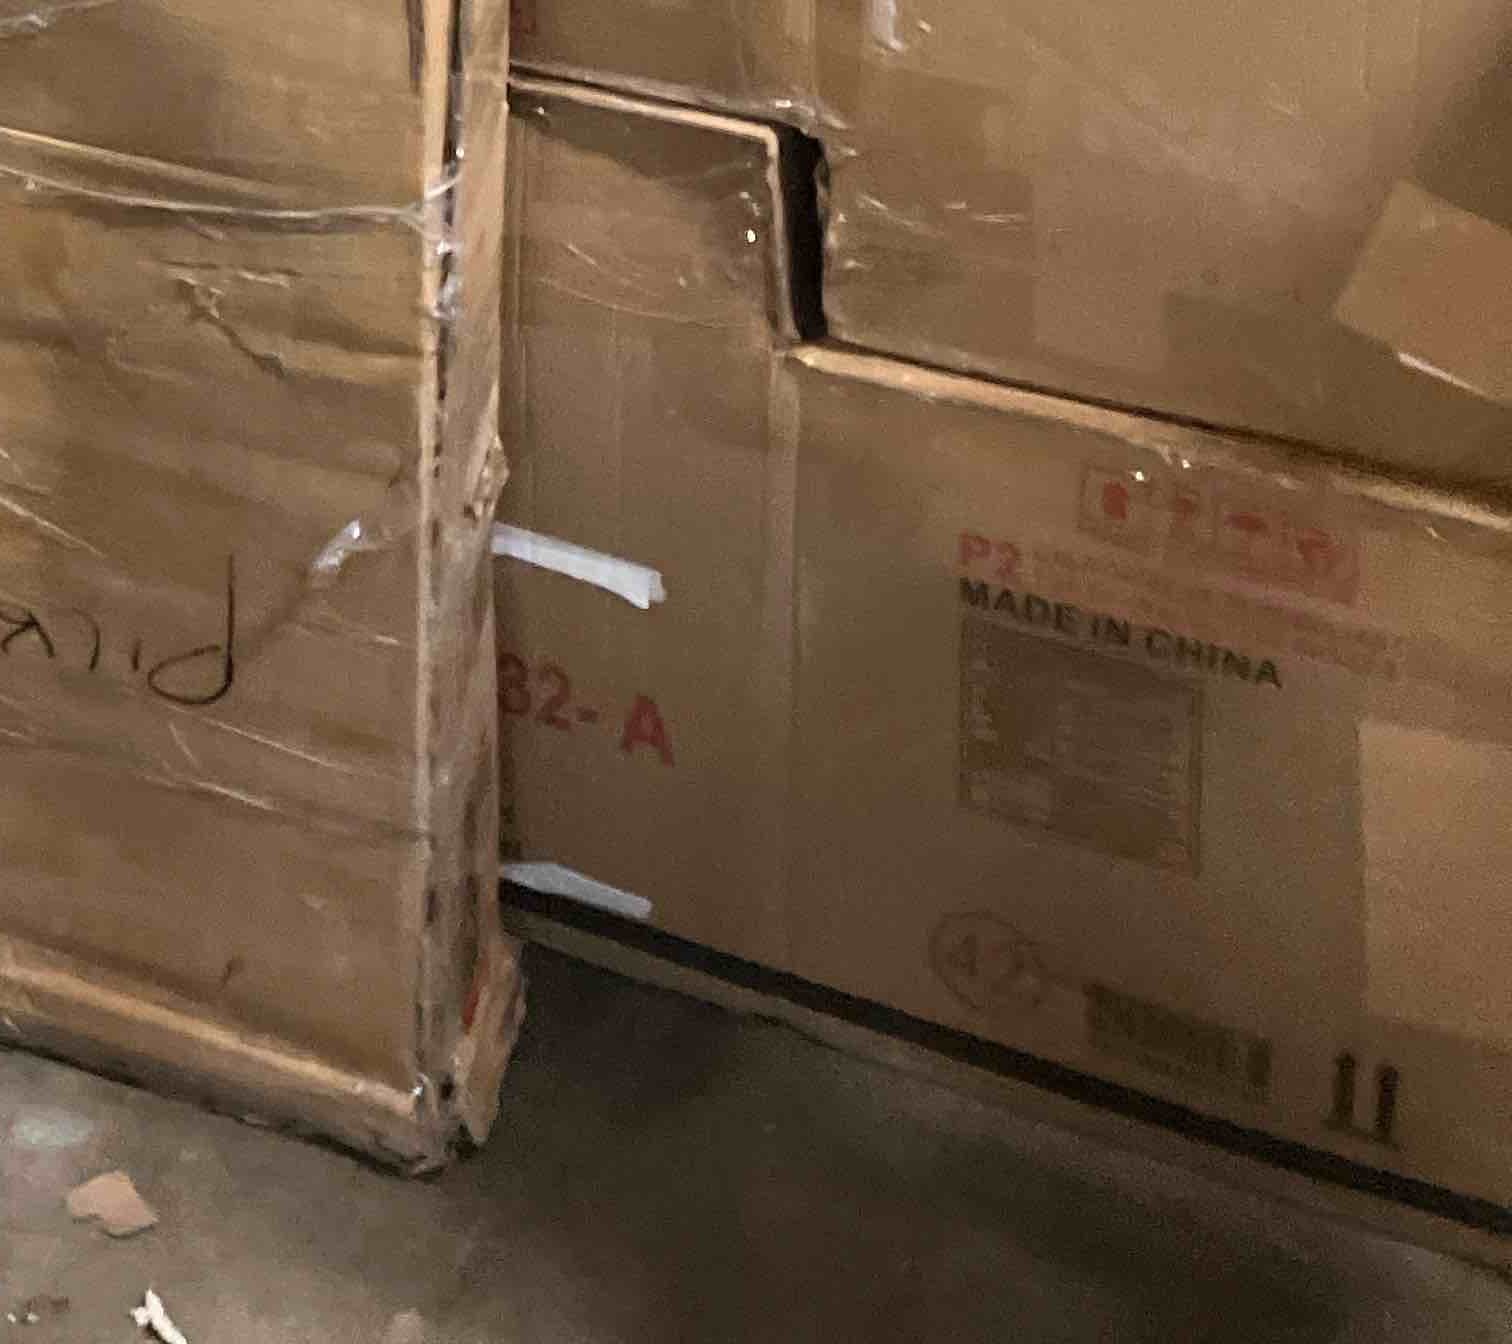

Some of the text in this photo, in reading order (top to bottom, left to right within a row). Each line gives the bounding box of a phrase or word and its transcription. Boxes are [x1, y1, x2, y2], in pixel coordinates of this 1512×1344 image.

[959, 576, 1077, 635] MADE
[1089, 612, 1132, 647] IN
[1143, 627, 1283, 689] CHINA
